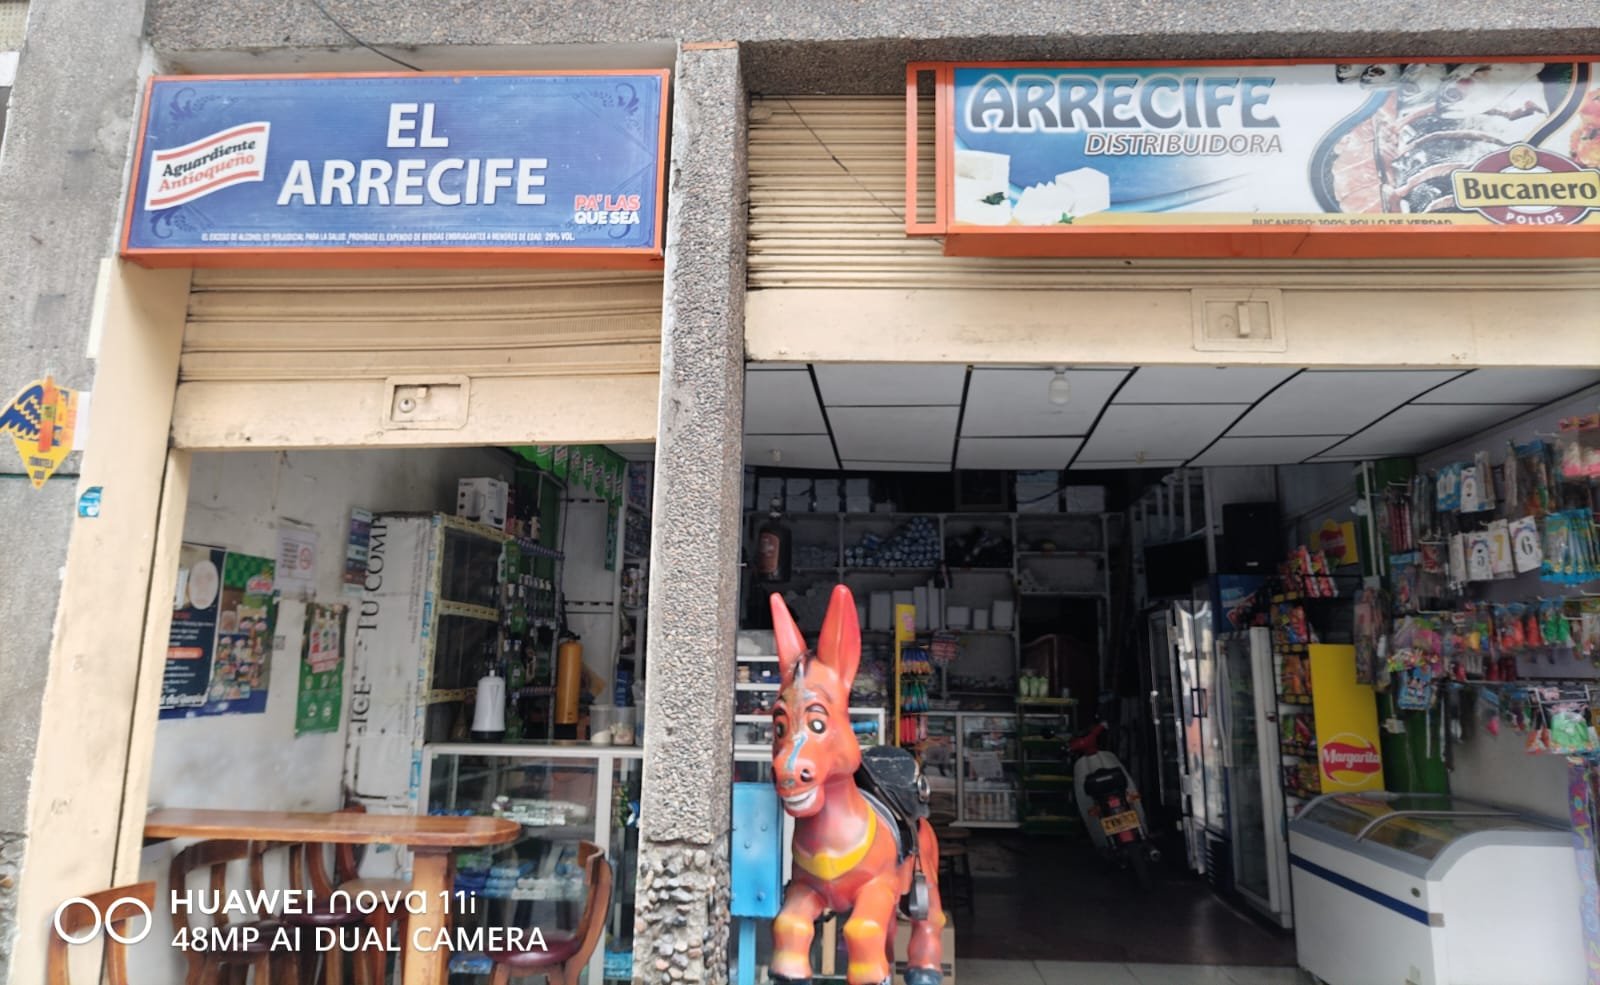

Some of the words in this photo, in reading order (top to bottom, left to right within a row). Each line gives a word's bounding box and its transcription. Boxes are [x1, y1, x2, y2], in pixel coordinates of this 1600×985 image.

[969, 75, 1282, 130] ARRECIFE
[386, 103, 449, 148] EL
[1085, 134, 1283, 155] DISTRIBUIDORA
[162, 140, 256, 177] Aguardiente
[158, 152, 256, 192] Antioqueño
[276, 158, 548, 206] ARRECIFE
[1462, 178, 1597, 200] Bucanero
[604, 194, 641, 211] LAS
[574, 211, 608, 225] QUE
[609, 211, 640, 225] SEA
[1506, 212, 1565, 225] POLLOS
[1521, 535, 1534, 556] 6
[1323, 748, 1380, 769] Margarita
